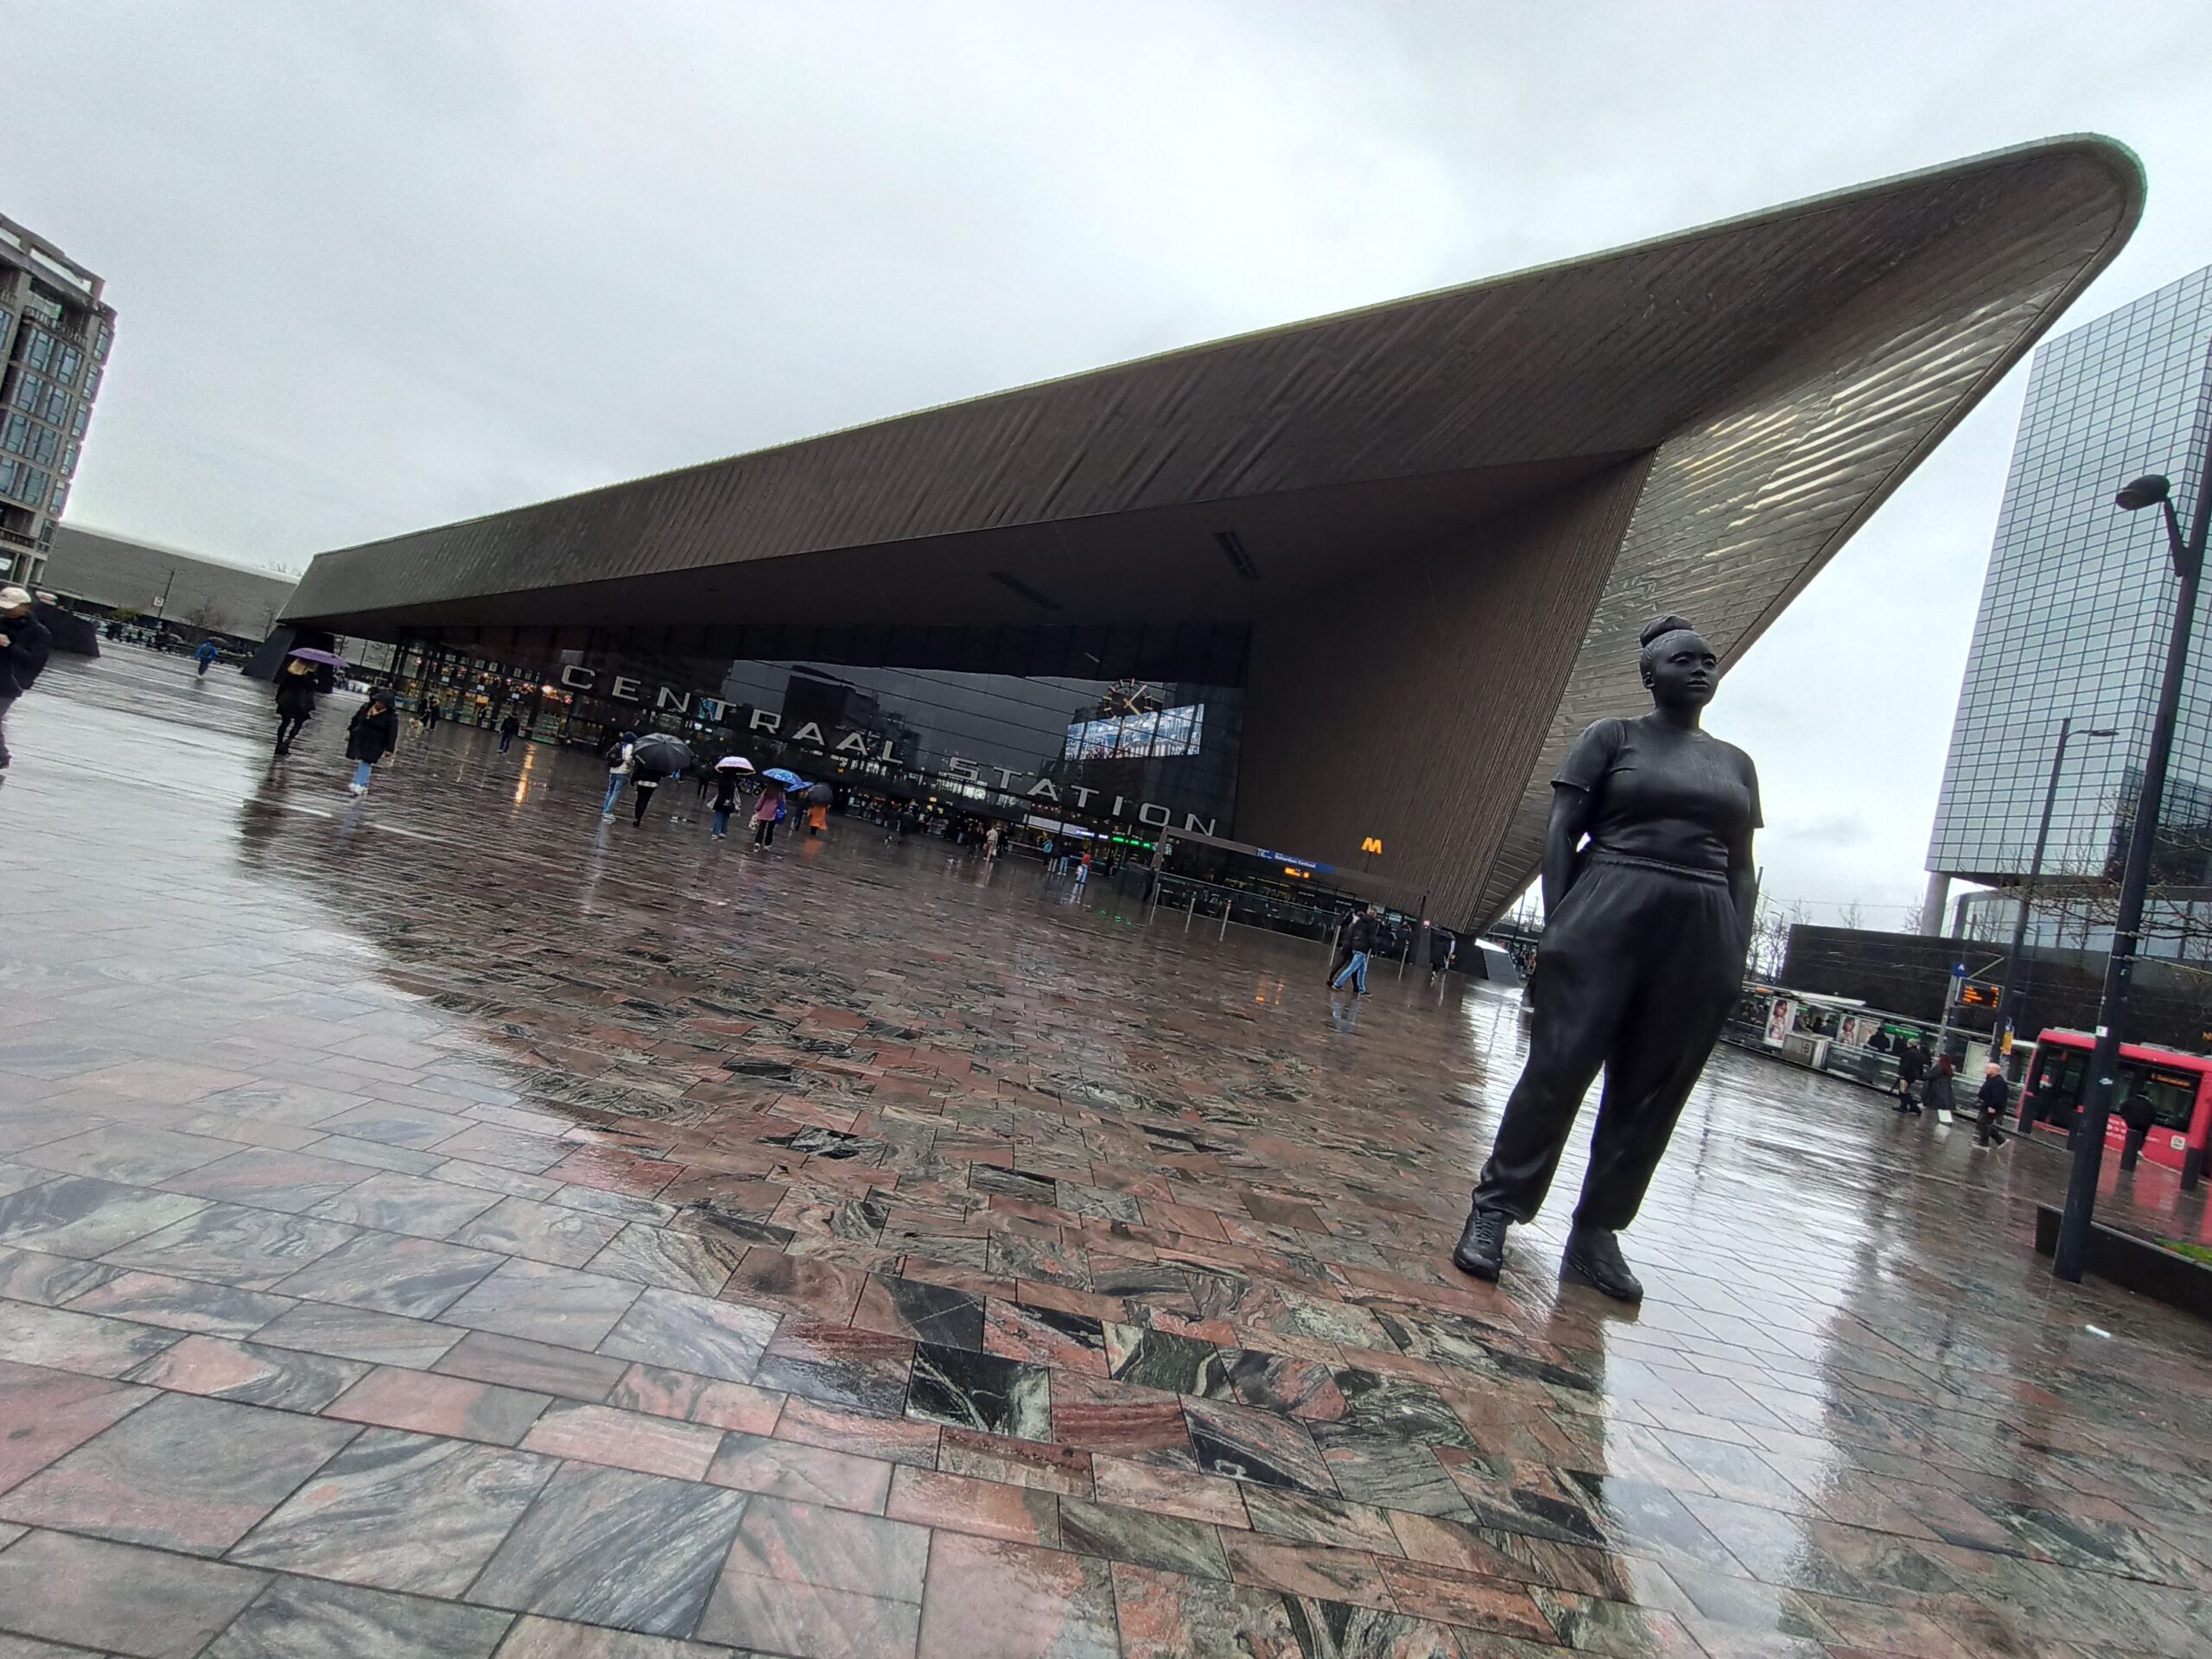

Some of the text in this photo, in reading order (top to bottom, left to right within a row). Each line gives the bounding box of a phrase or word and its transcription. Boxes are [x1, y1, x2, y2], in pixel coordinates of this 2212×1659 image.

[562, 664, 1216, 836] CENTRAAL STATION
[1361, 836, 1382, 855] M
